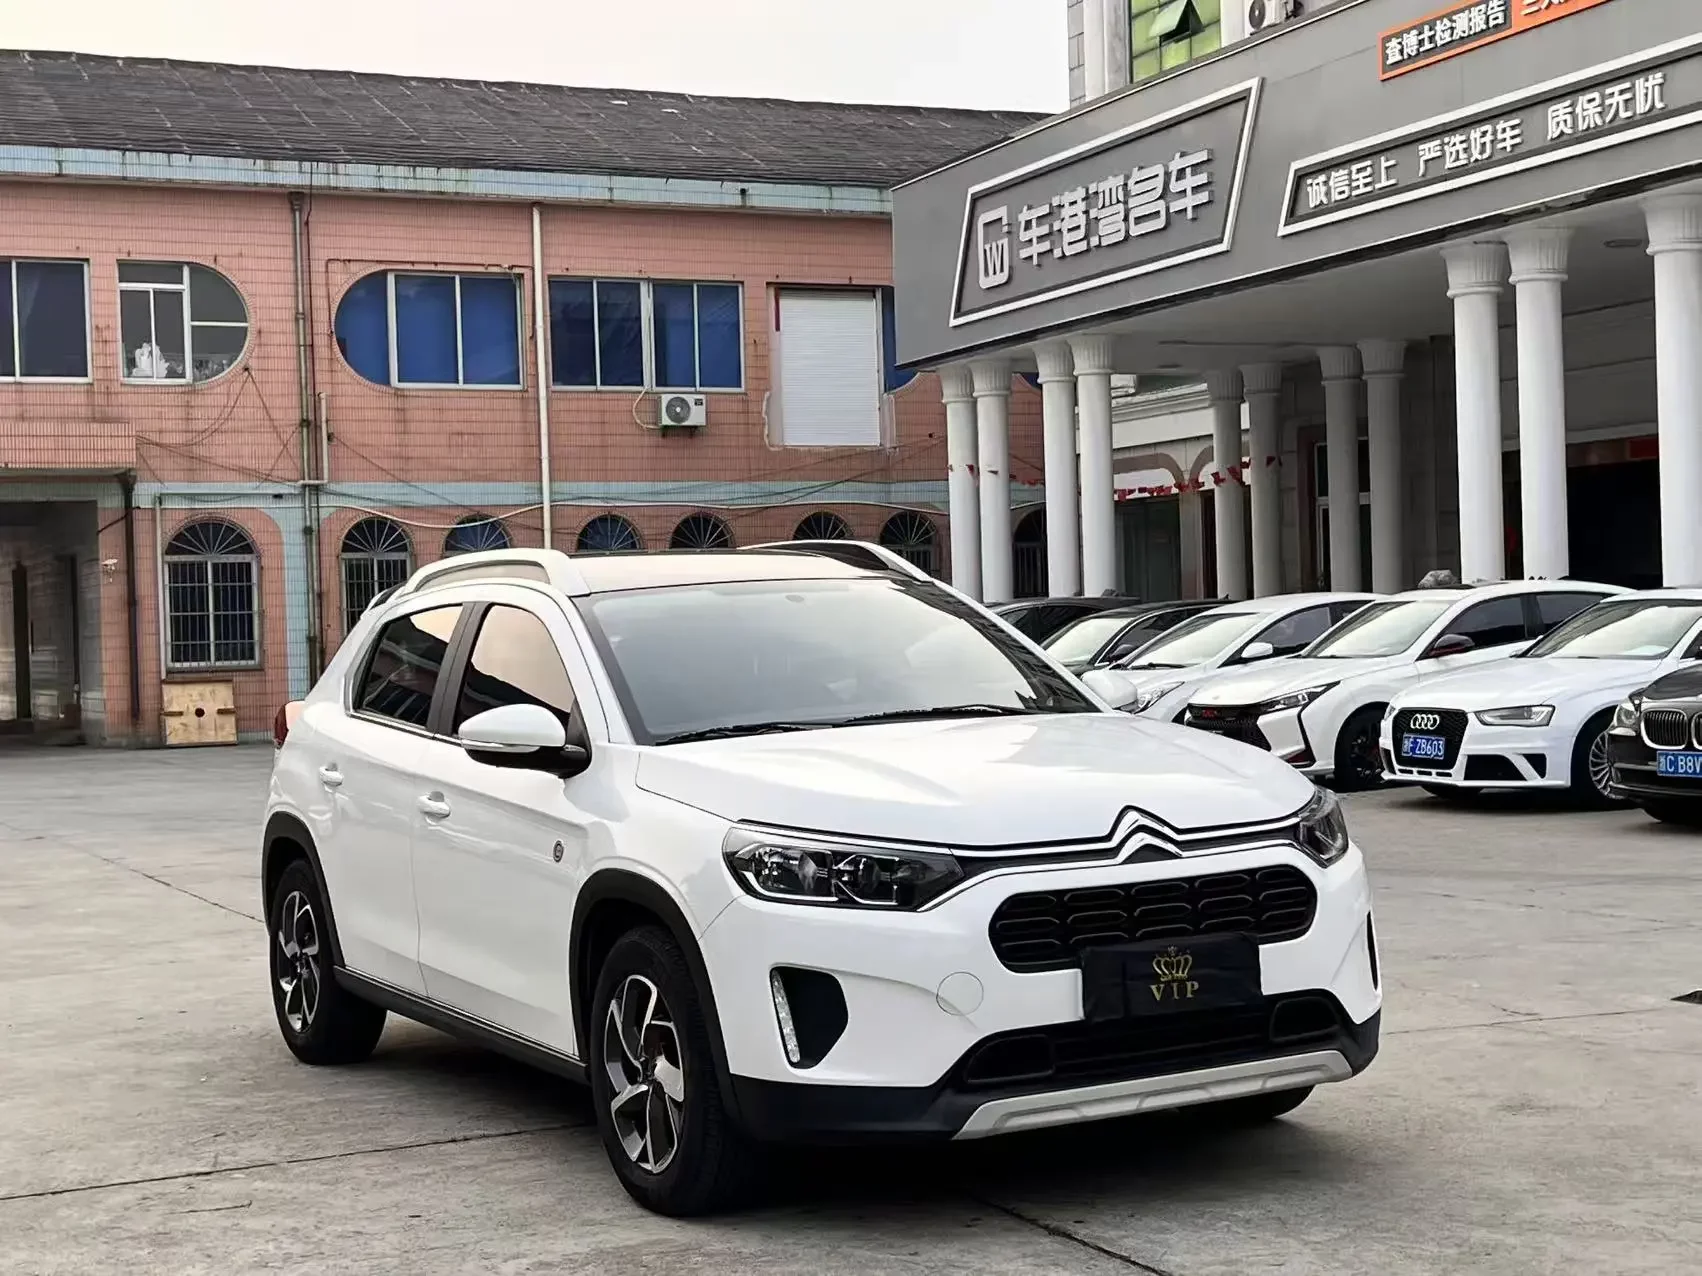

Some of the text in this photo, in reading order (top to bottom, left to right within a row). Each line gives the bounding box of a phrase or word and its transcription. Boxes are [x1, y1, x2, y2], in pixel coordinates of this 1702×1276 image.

[1385, 0, 1506, 65] 查博士检测报告
[1306, 71, 1666, 208] 诚信至上 严选好车 质保无忧
[1018, 148, 1214, 267] 车港湾名车
[1415, 738, 1444, 756] ZB603
[1150, 980, 1200, 1001] VIP
